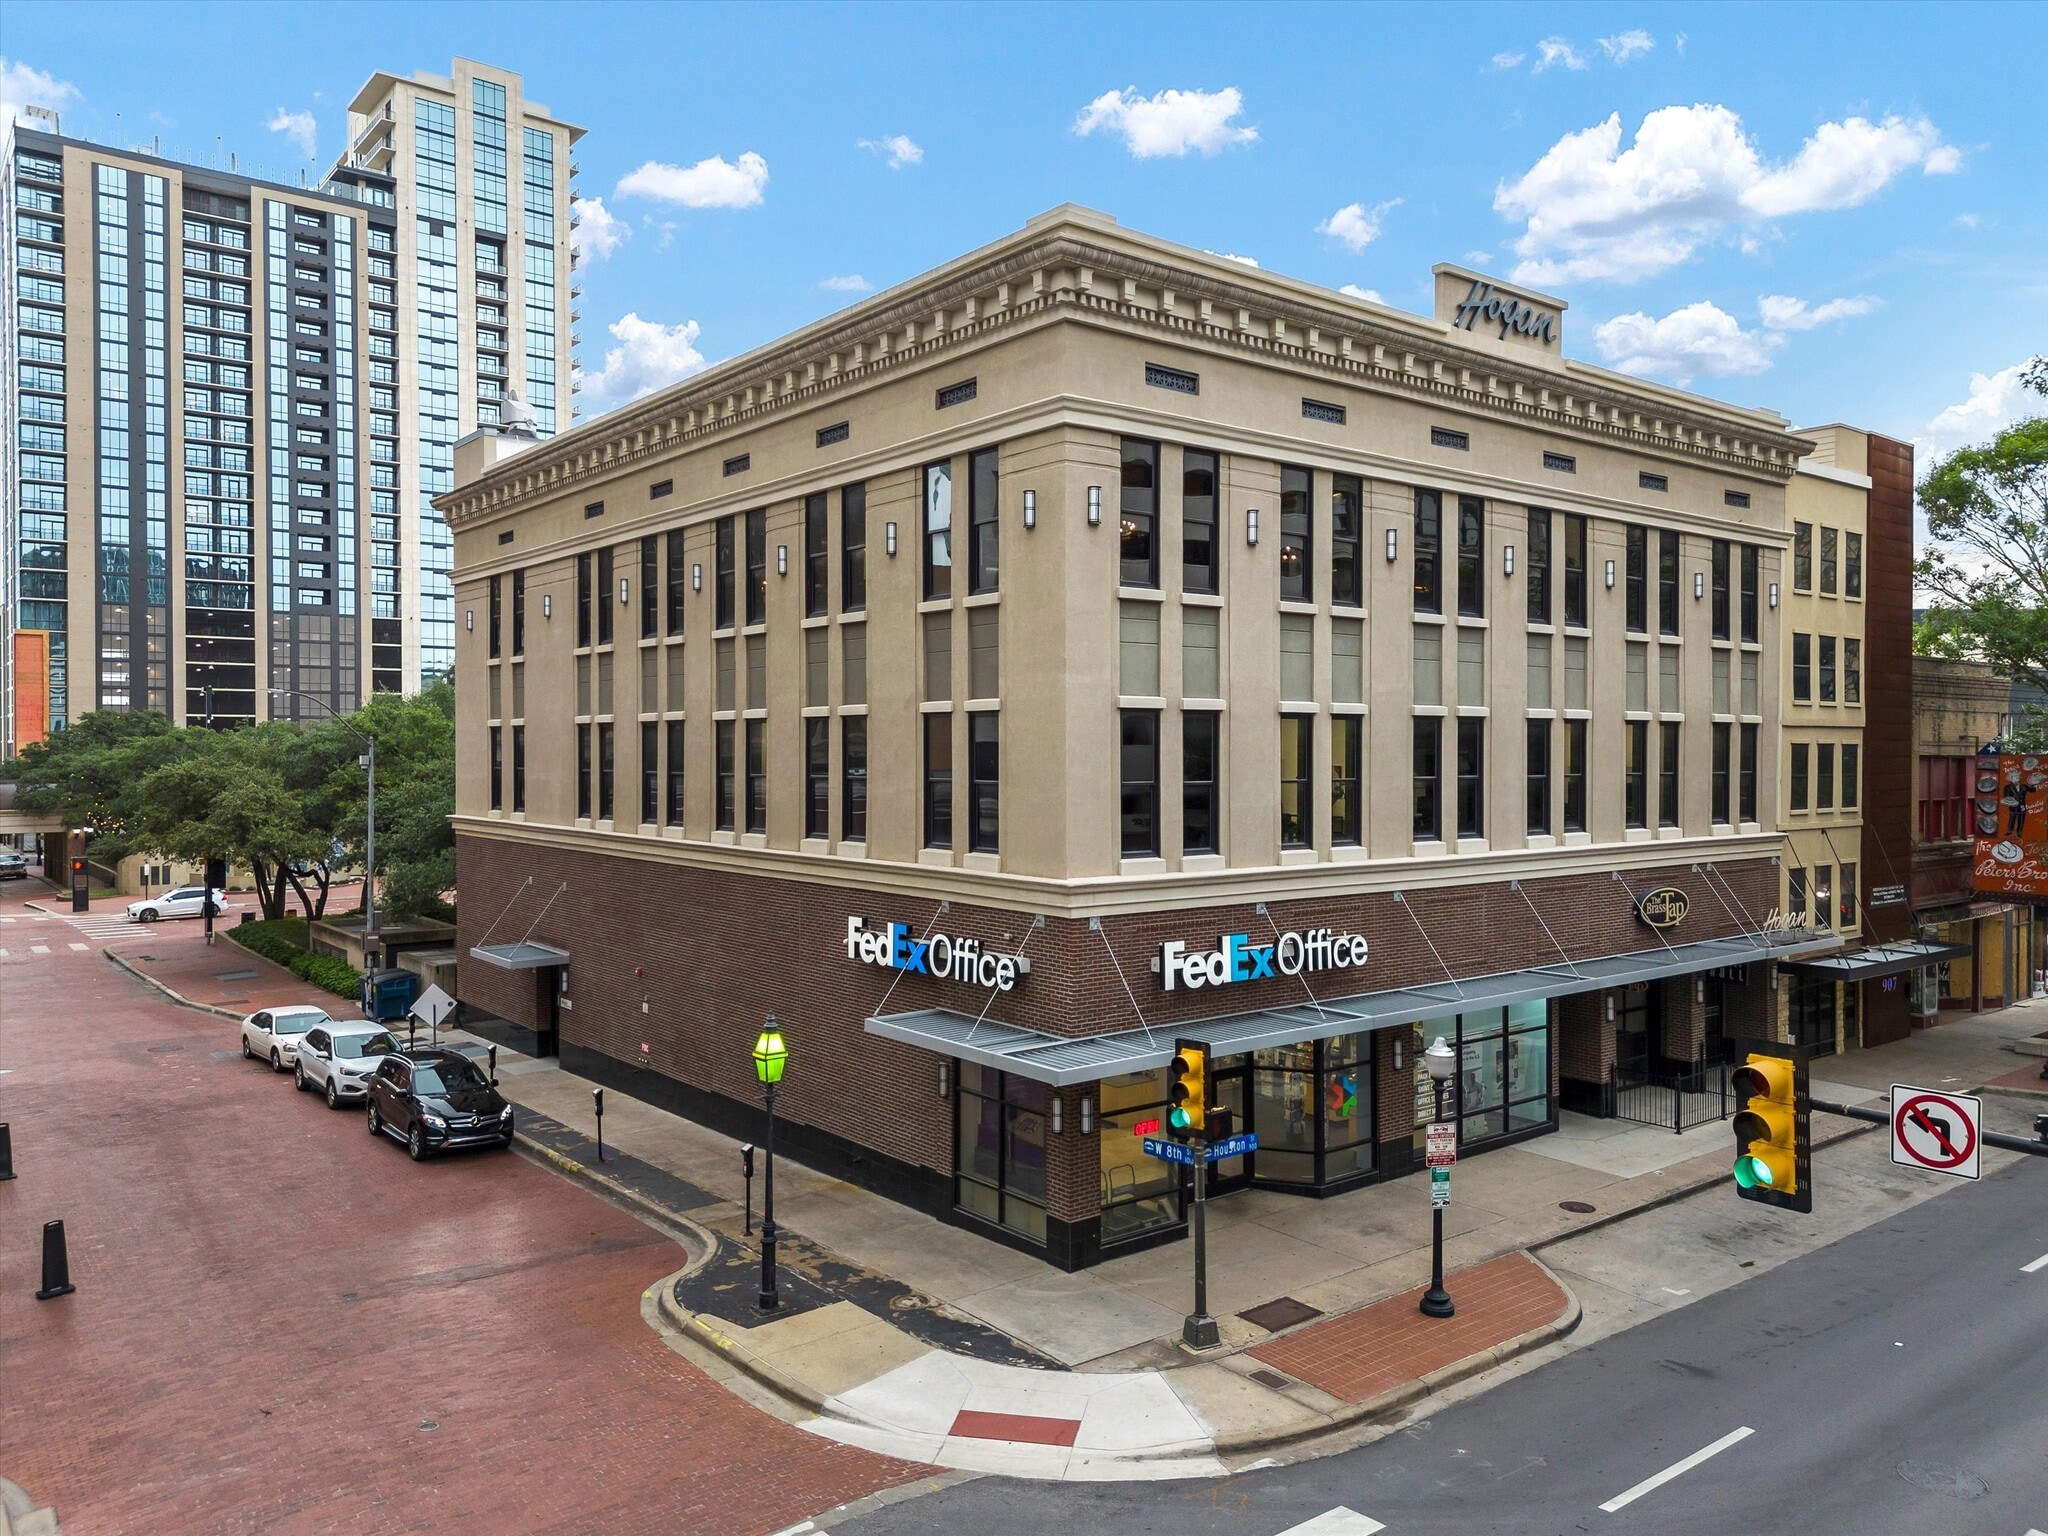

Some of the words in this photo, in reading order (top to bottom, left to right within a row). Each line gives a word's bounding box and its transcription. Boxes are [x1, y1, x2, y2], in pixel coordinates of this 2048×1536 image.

[1453, 280, 1556, 343] Hogan
[1975, 840, 1992, 856] The
[1975, 858, 2016, 878] Peters
[1646, 902, 1666, 915] Brass
[1660, 892, 1684, 926] Tap
[847, 915, 928, 975] FedEx
[929, 933, 1015, 992] Office
[1163, 932, 1276, 991] FedEx
[1277, 928, 1369, 976] Office
[1882, 976, 1897, 993] 907
[1135, 1119, 1159, 1135] OPEN
[1155, 1142, 1162, 1155] W
[1166, 1145, 1182, 1160] 8th
[1213, 1140, 1246, 1157] Houston
